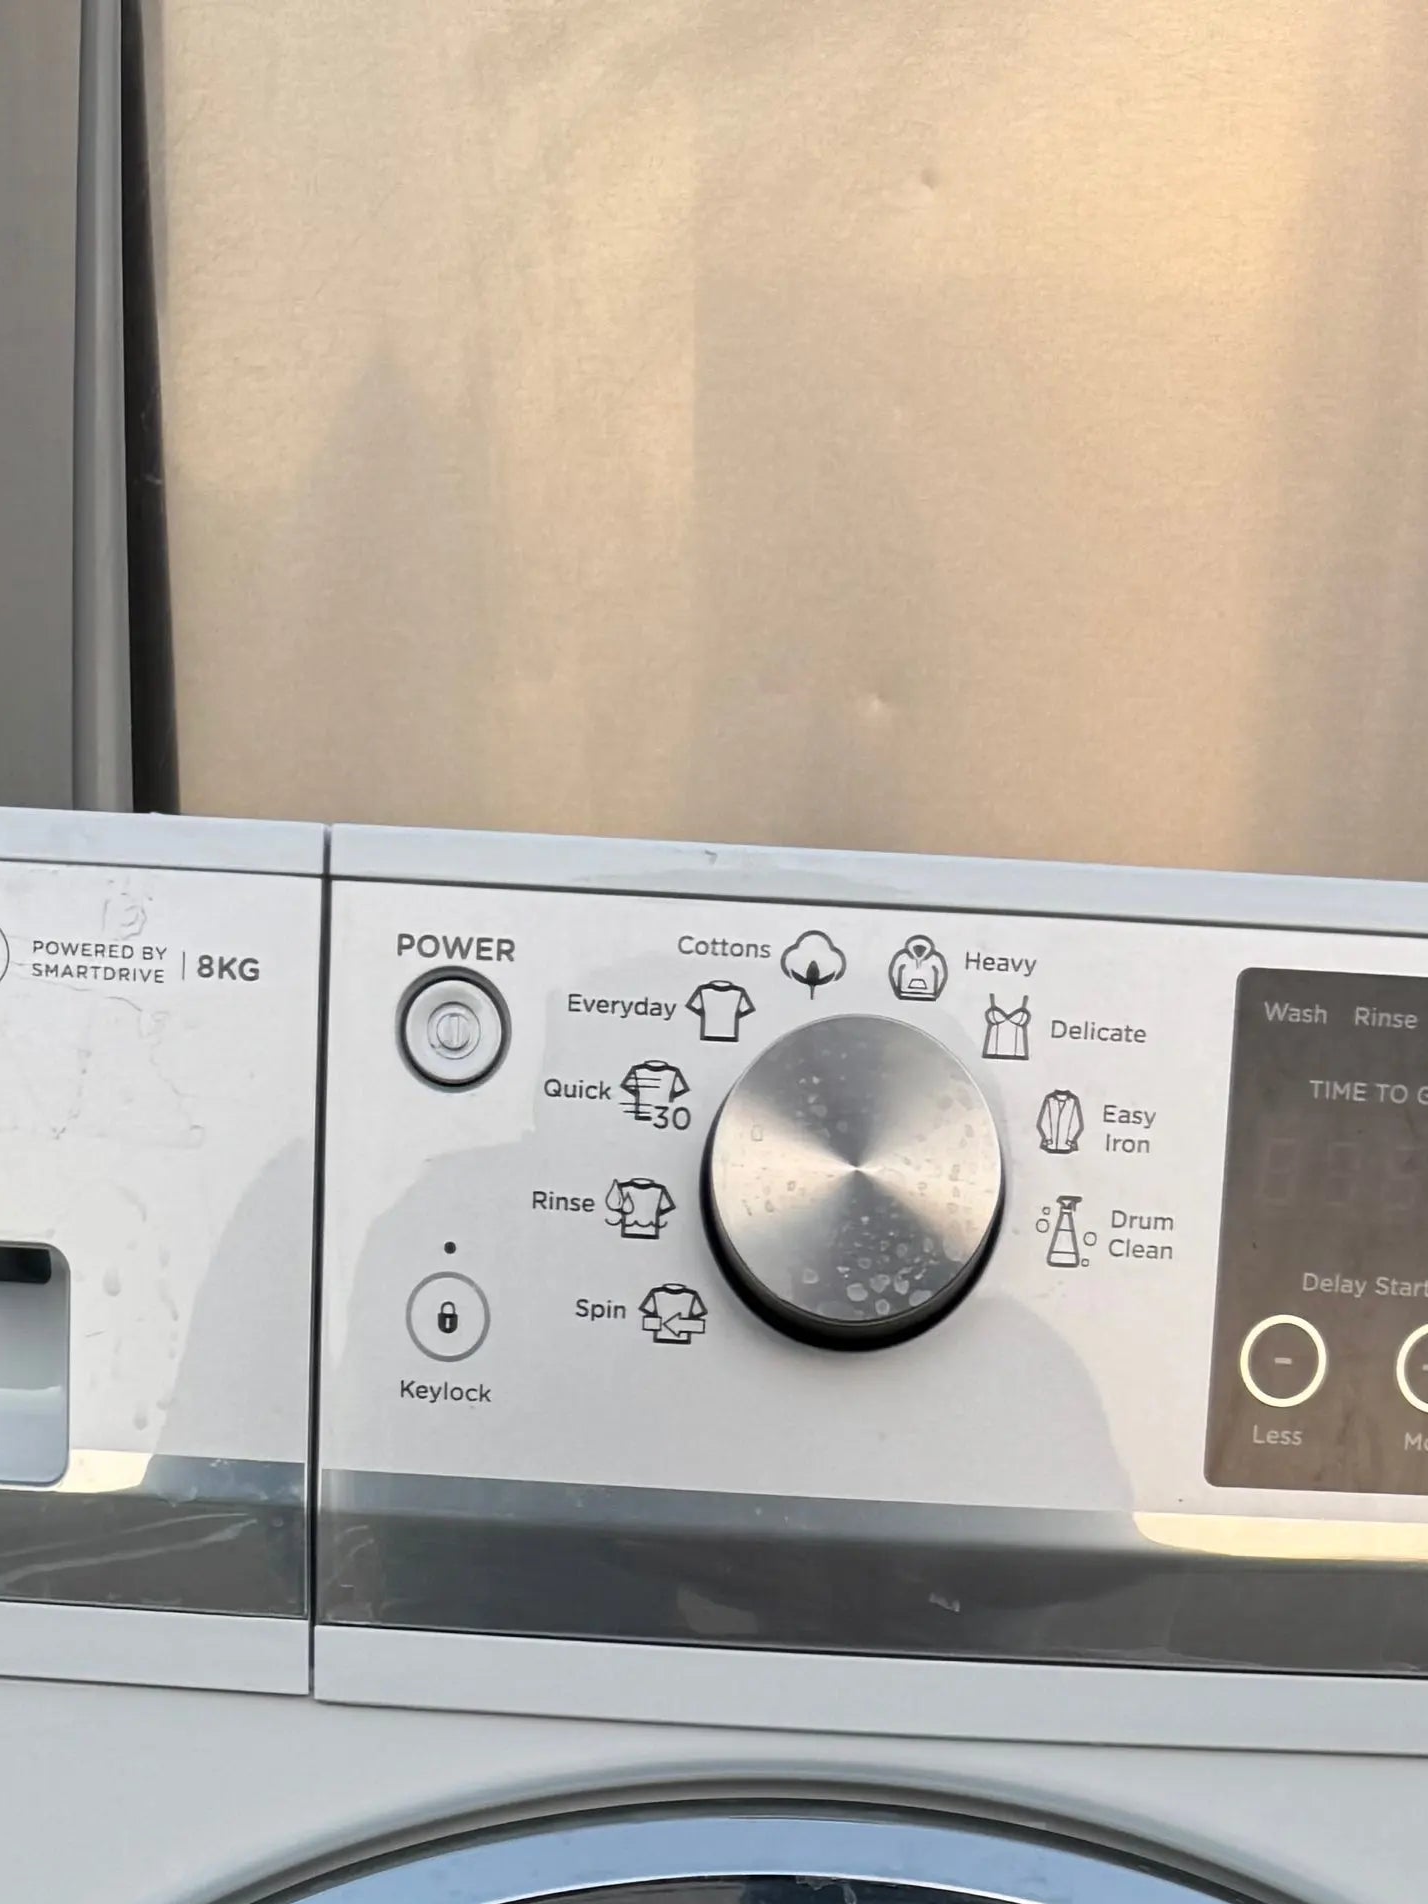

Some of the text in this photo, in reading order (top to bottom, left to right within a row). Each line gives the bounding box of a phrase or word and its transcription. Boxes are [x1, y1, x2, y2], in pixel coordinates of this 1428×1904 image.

[33, 941, 166, 960] POWERED BY
[398, 934, 515, 961] POWER
[678, 936, 770, 958] Cottons
[32, 963, 164, 983] SMARTDRIVE
[197, 955, 259, 981] 8KG
[966, 952, 1036, 977] Heavy
[569, 994, 676, 1021] Everyday
[1265, 1002, 1327, 1024] Wash
[1355, 1007, 1417, 1029] Rinse
[1051, 1020, 1146, 1043] Delicate
[544, 1079, 611, 1099] Quick
[1310, 1080, 1367, 1101] TIME
[1376, 1084, 1408, 1103] TO
[653, 1106, 691, 1130] 30
[1103, 1105, 1156, 1129] Easy
[1106, 1134, 1149, 1153] Iron
[533, 1191, 595, 1212] Rinse
[1112, 1210, 1173, 1230] Drum
[1109, 1239, 1172, 1259] Clean
[1303, 1273, 1366, 1298] Delay
[576, 1299, 625, 1321] Spin
[401, 1380, 491, 1403] Keylock
[1253, 1425, 1301, 1445] Less
